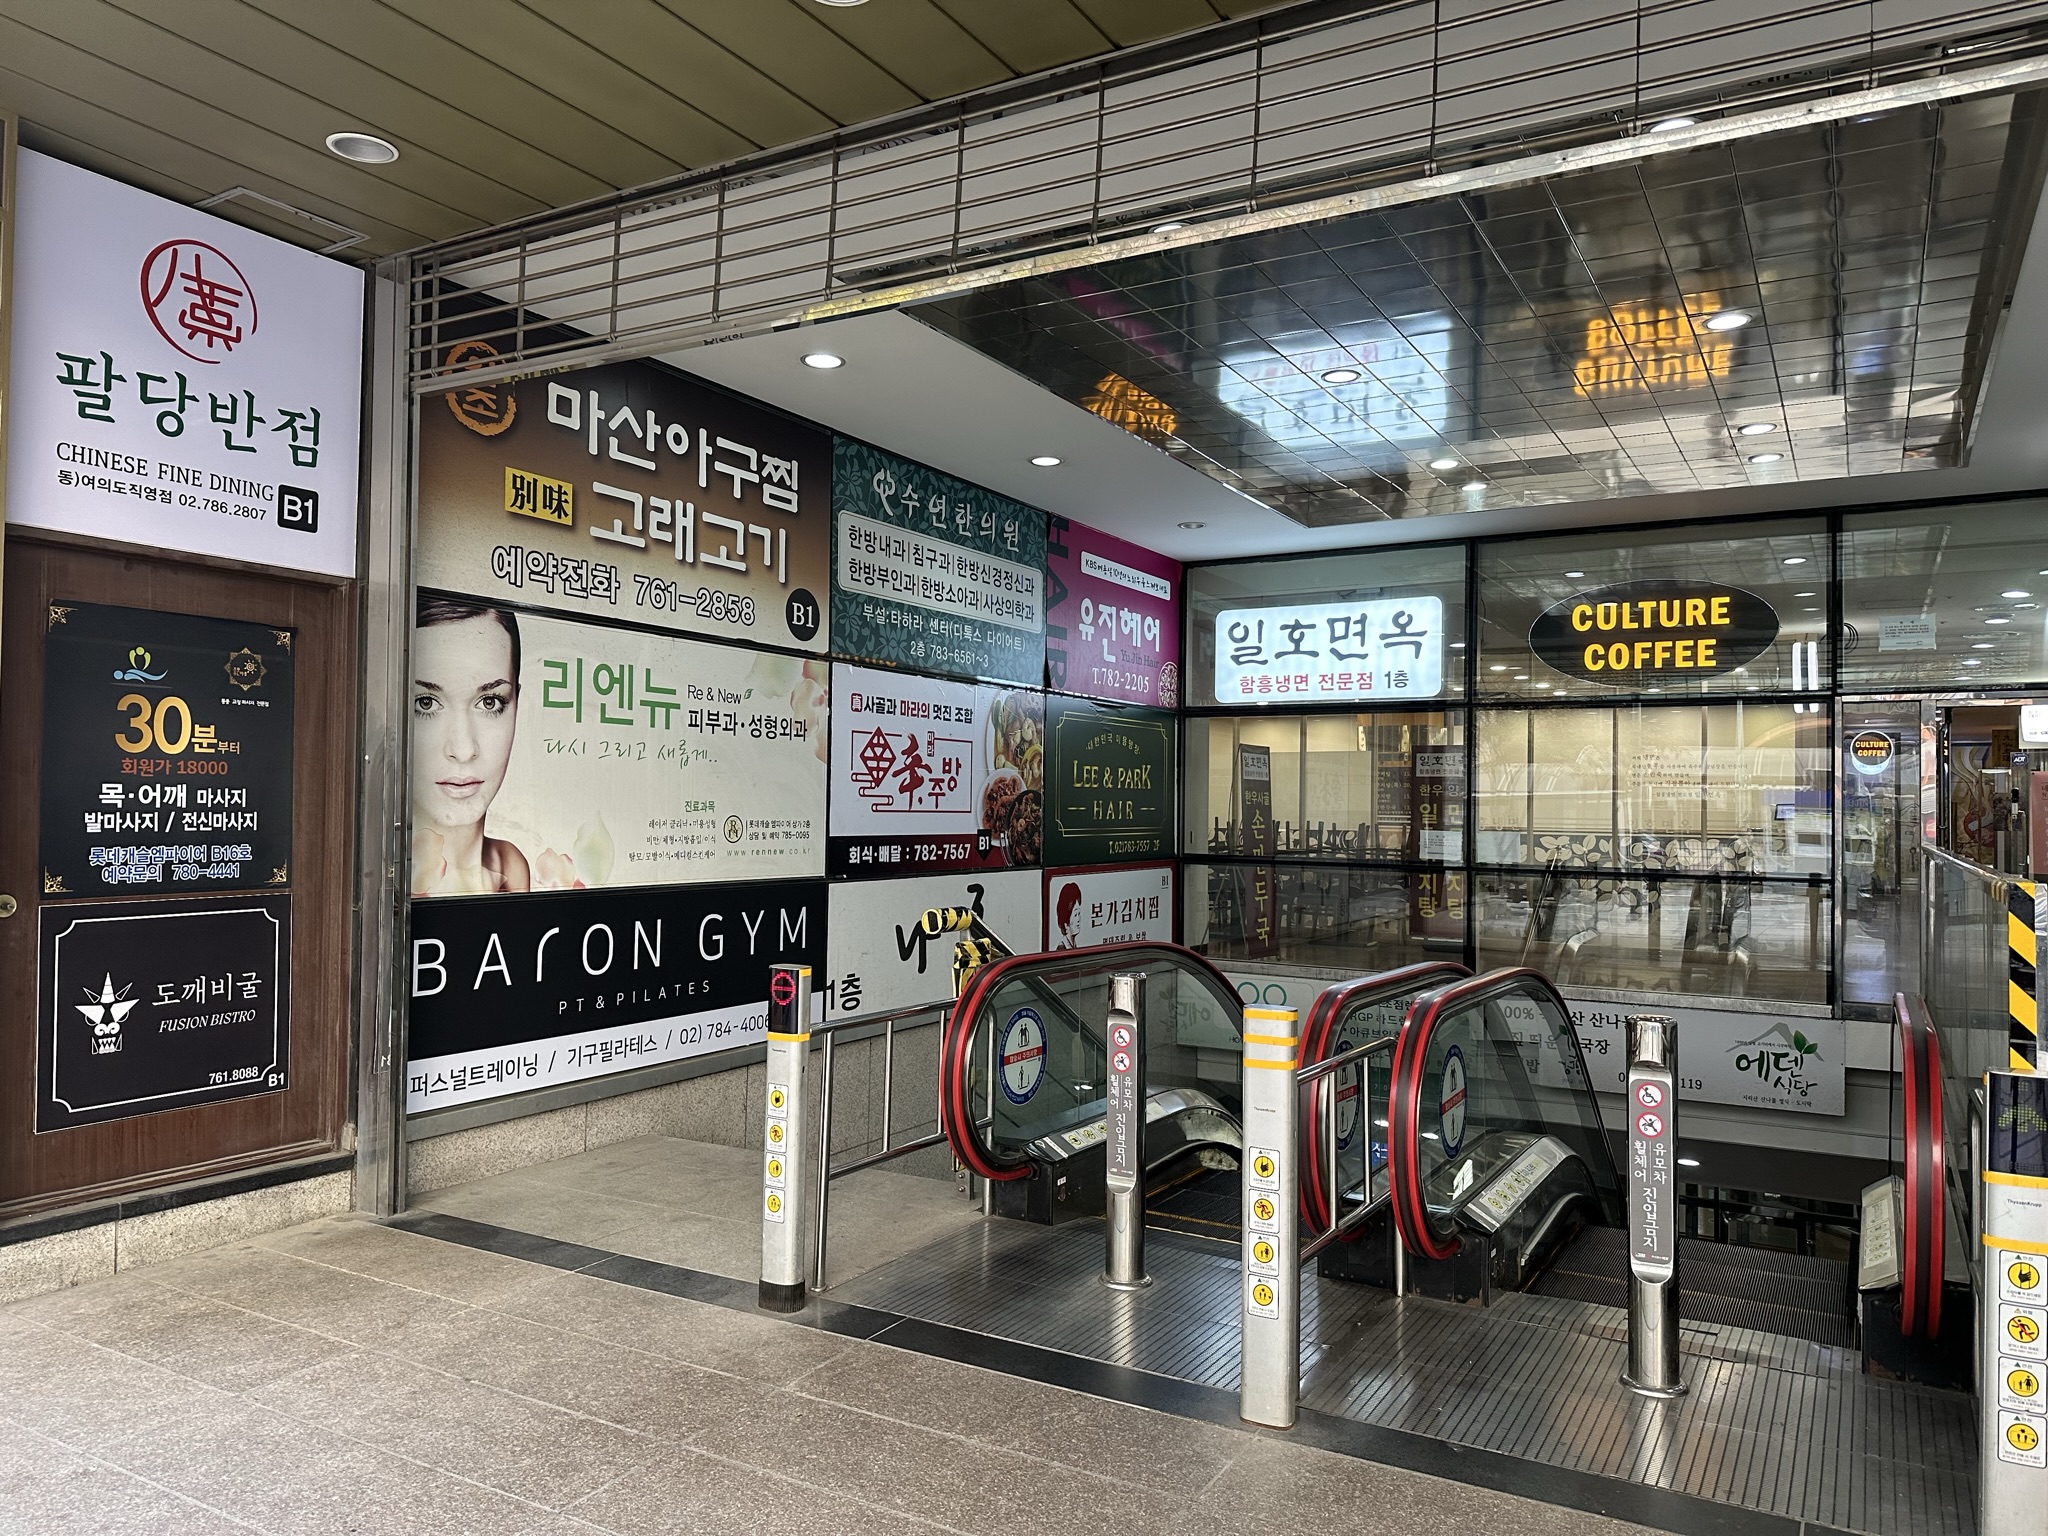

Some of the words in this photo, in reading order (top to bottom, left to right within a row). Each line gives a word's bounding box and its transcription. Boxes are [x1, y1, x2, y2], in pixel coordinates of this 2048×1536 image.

[55, 350, 321, 469] 팔당반점
[547, 381, 799, 513] 마산아구찜
[56, 442, 148, 477] CHINESE
[158, 462, 203, 488] FINE
[209, 473, 275, 502] DINING
[57, 469, 173, 504] 동)여의도직영점
[178, 494, 267, 521] 02.786.2807
[283, 495, 314, 525] B1
[510, 474, 571, 521] 別味
[589, 481, 786, 584] 고래고기
[901, 483, 1019, 552] 수연한의원
[848, 524, 906, 562] 한방내과
[912, 544, 950, 574] 침구과
[956, 555, 1036, 597] 한방신경정신과
[492, 546, 620, 604] 예약전화
[634, 574, 755, 627] 761-2858
[848, 557, 916, 596] 한방부인과
[921, 576, 979, 611] 한방소아과
[792, 601, 815, 628] B1
[1078, 597, 1160, 663] 유진헤어
[1571, 596, 1731, 633] CULTURE
[910, 641, 926, 658] 2층
[1228, 610, 1428, 666] 일호면옥
[1583, 638, 1717, 671] COFFEE
[542, 657, 682, 730] 리엔뉴
[687, 684, 704, 702] Re
[706, 687, 715, 702] &
[717, 687, 742, 705] New
[1092, 668, 1149, 692] T.782-2205
[1240, 673, 1310, 694] 함흥냉면
[1318, 671, 1373, 691] 전문점
[1384, 671, 1409, 689] 1층
[864, 696, 897, 716] 사골과
[900, 700, 930, 719] 마라의
[932, 705, 952, 722] 멋진
[954, 707, 973, 724] 조합
[543, 737, 586, 757] 다시
[598, 739, 648, 762] 그리고
[1857, 749, 1887, 757] COFFEE
[120, 757, 172, 777] 회원가
[177, 760, 228, 775] 18000
[1073, 760, 1099, 788] LEE
[1103, 767, 1113, 788] &
[1118, 765, 1152, 789] PARK
[98, 783, 187, 808] 목·어깨
[197, 788, 247, 808] 마사지
[684, 800, 716, 813] 진료과목
[1093, 800, 1134, 820] HAIR
[84, 811, 159, 833] 발마사지
[182, 811, 258, 831] 전신마사지
[89, 845, 207, 866] 롯데캐슬엠파이어
[211, 844, 252, 861] B16호
[914, 844, 971, 861] 782-7567
[979, 836, 990, 850] B1
[102, 864, 162, 884] 예약문의
[172, 863, 240, 881] 780-4441
[1162, 875, 1169, 886] B1
[1091, 896, 1160, 928] 본가김치찜
[700, 907, 807, 961] GYM
[152, 971, 262, 1007] 도깨비굴
[826, 973, 862, 1011] 1층
[159, 1014, 209, 1033] FUSION
[210, 1009, 255, 1027] BISTRO
[1588, 1012, 1628, 1030] 산나
[209, 1066, 259, 1085] 761.8088
[410, 1054, 539, 1098] 퍼스널트레이닝
[567, 1034, 658, 1068] 기구필라테스
[680, 1024, 703, 1046] 02)
[1736, 1050, 1804, 1082] 에덴
[268, 1072, 285, 1087] B1
[1123, 1077, 1133, 1112] 유모차
[1773, 1076, 1817, 1097] 식당
[1115, 1113, 1126, 1167] 진입금지
[1634, 1140, 1647, 1183] 휠체어
[1653, 1143, 1667, 1185] 유모차
[1643, 1187, 1659, 1251] 진입금지
